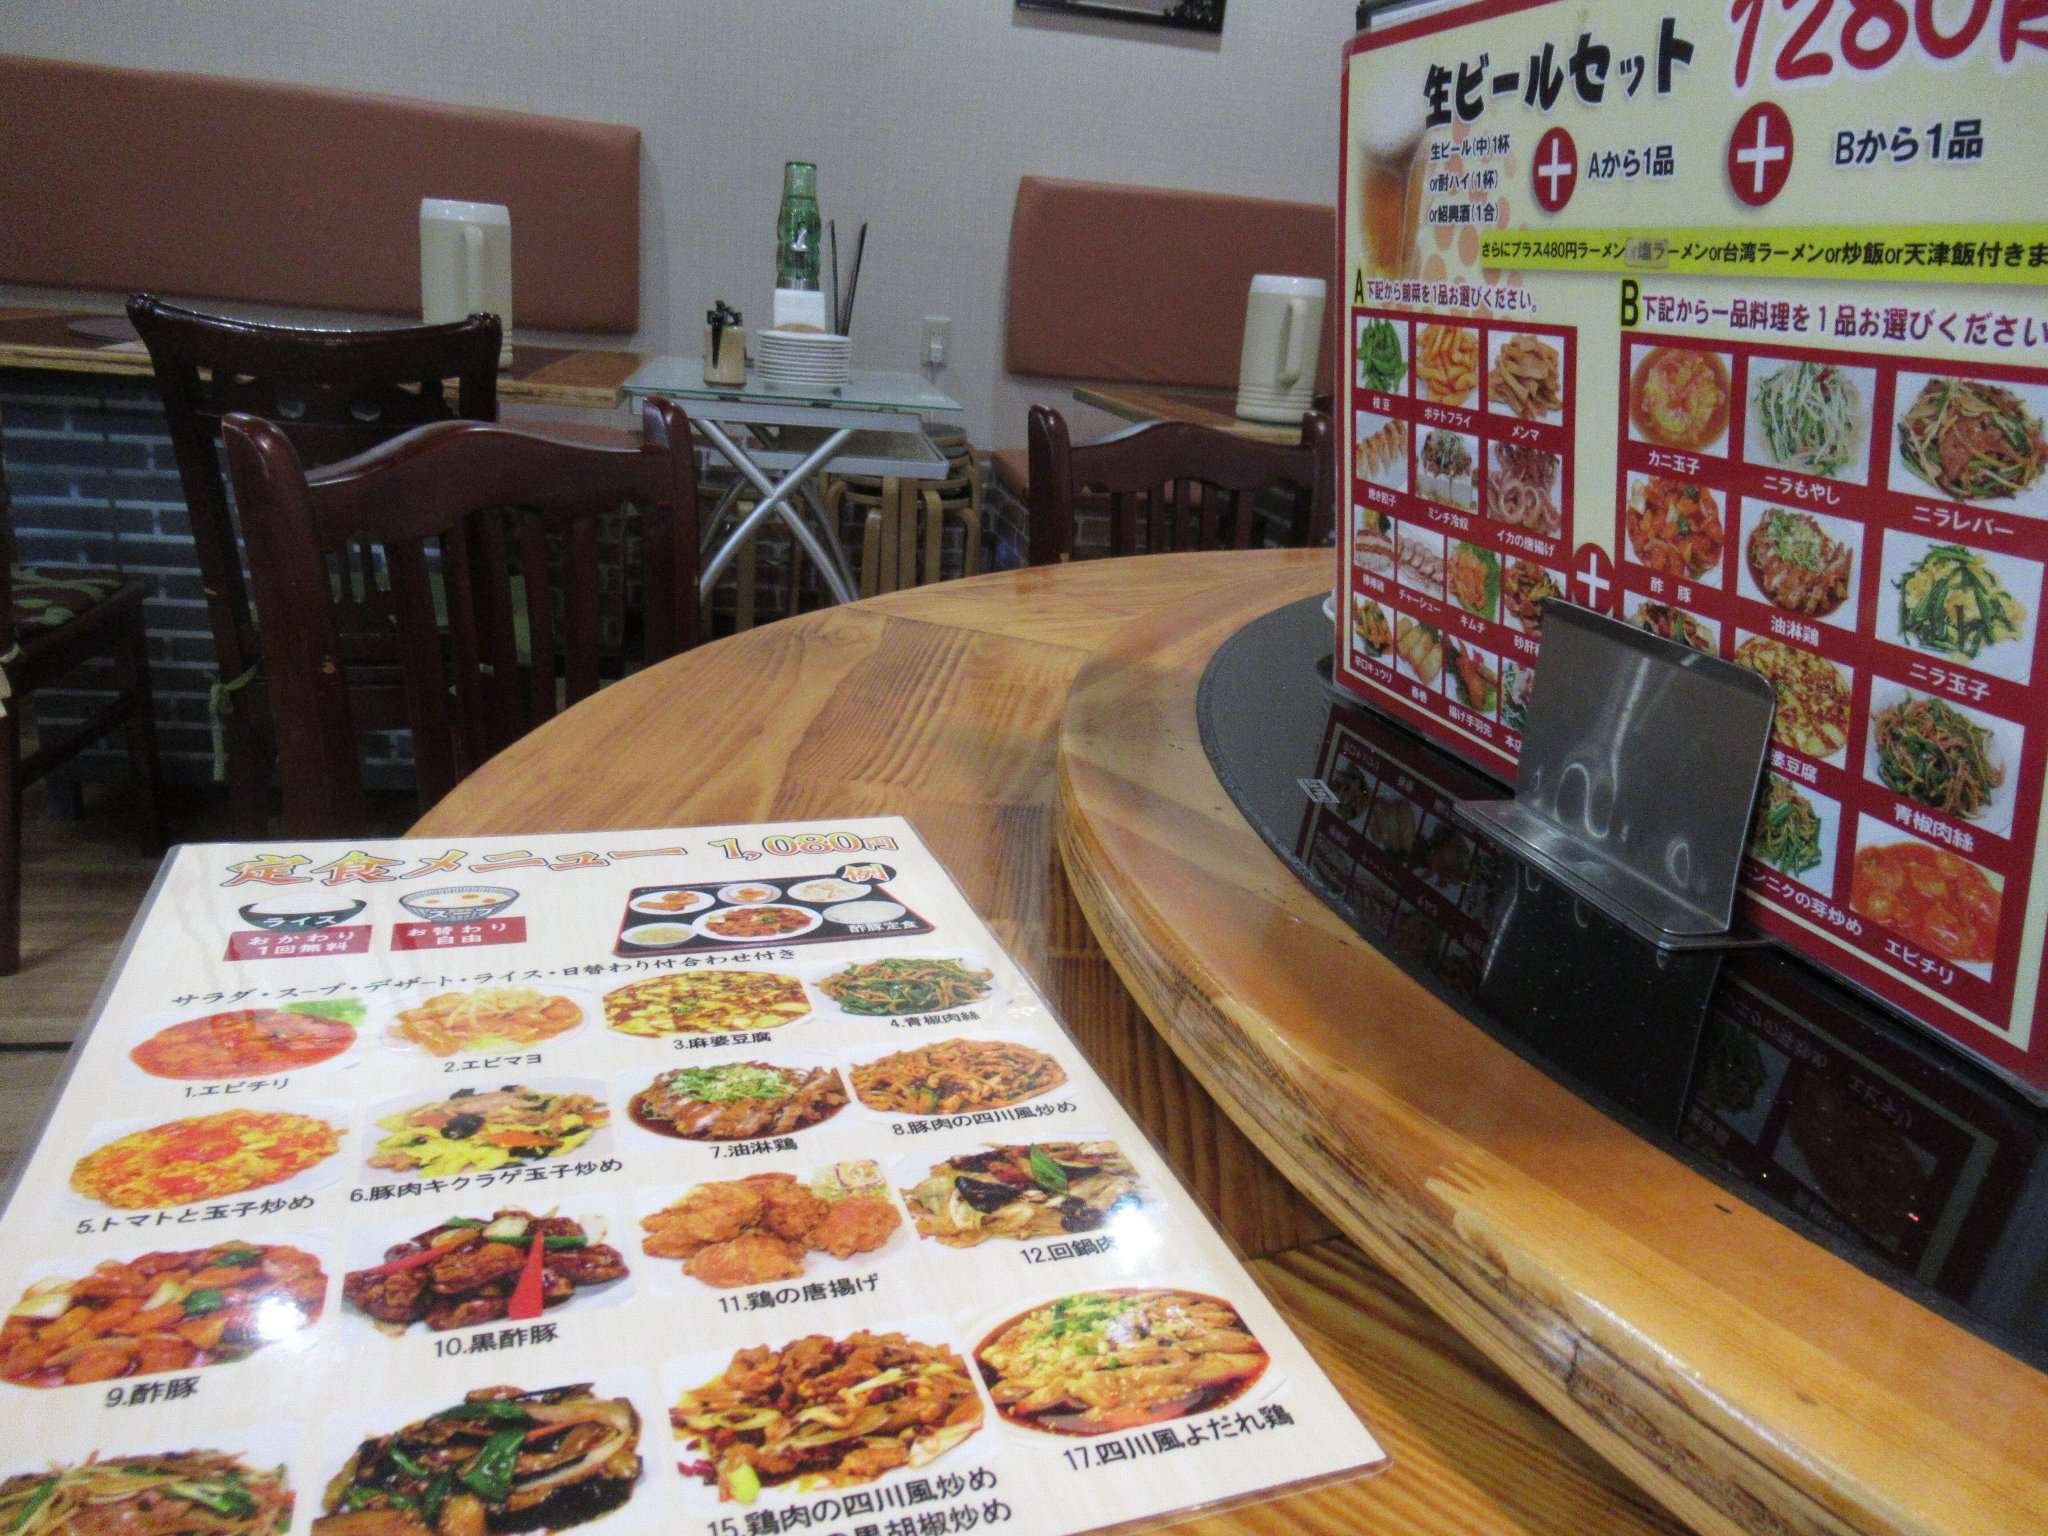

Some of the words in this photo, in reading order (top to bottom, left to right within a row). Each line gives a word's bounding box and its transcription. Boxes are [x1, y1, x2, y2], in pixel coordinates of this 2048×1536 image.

[1423, 17, 1694, 128] 生ビールセット
[1834, 118, 1983, 166] Bから1品
[1587, 144, 1674, 180] Aから1品
[1354, 268, 1364, 304] A
[1621, 279, 1640, 327] B
[1424, 408, 1473, 428] ポテトフライ
[1511, 425, 1540, 442] メンマ
[1648, 450, 1700, 476] カニ玉子
[1764, 475, 1840, 506] ニラもやし
[1912, 505, 2014, 536] ニラレバー
[1399, 588, 1441, 613] チャーシュー
[1460, 614, 1486, 634] キムチ
[1770, 615, 1820, 647] 油淋鶏
[1909, 662, 1990, 701] ニラ玉子
[1894, 803, 1975, 854] 青椒肉絲
[220, 845, 688, 887] 定食メニュー
[708, 831, 899, 862] 1,080円
[842, 863, 889, 883] 例
[263, 915, 338, 927] ライス
[408, 921, 507, 937] お替わり
[248, 931, 355, 947] おかわり
[257, 941, 349, 956] 1回無料
[436, 934, 482, 946] 自由
[1885, 938, 1954, 985] エビチリ
[673, 1032, 772, 1051] 3.麻婆豆腐
[444, 1052, 542, 1073] 2.エビマヨ
[185, 1077, 289, 1099] 1.エビチリ
[892, 1101, 1078, 1137] 8.豚肉の四川風炒め
[710, 1138, 798, 1158] 7.油淋鶏
[350, 1159, 624, 1203] 6.豚肉キクラゲ玉子炒め
[76, 1195, 315, 1236] 5.トマトと玉子炒め
[718, 1272, 880, 1315] 11.鶏の唐揚げ
[434, 1322, 560, 1358] 10.黒酢豚
[105, 1375, 200, 1409] 9.酢豚
[1063, 1404, 1295, 1471] 17.四川風よだれ鶏
[706, 1466, 999, 1536] 15.鶏肉の四川風炒め
